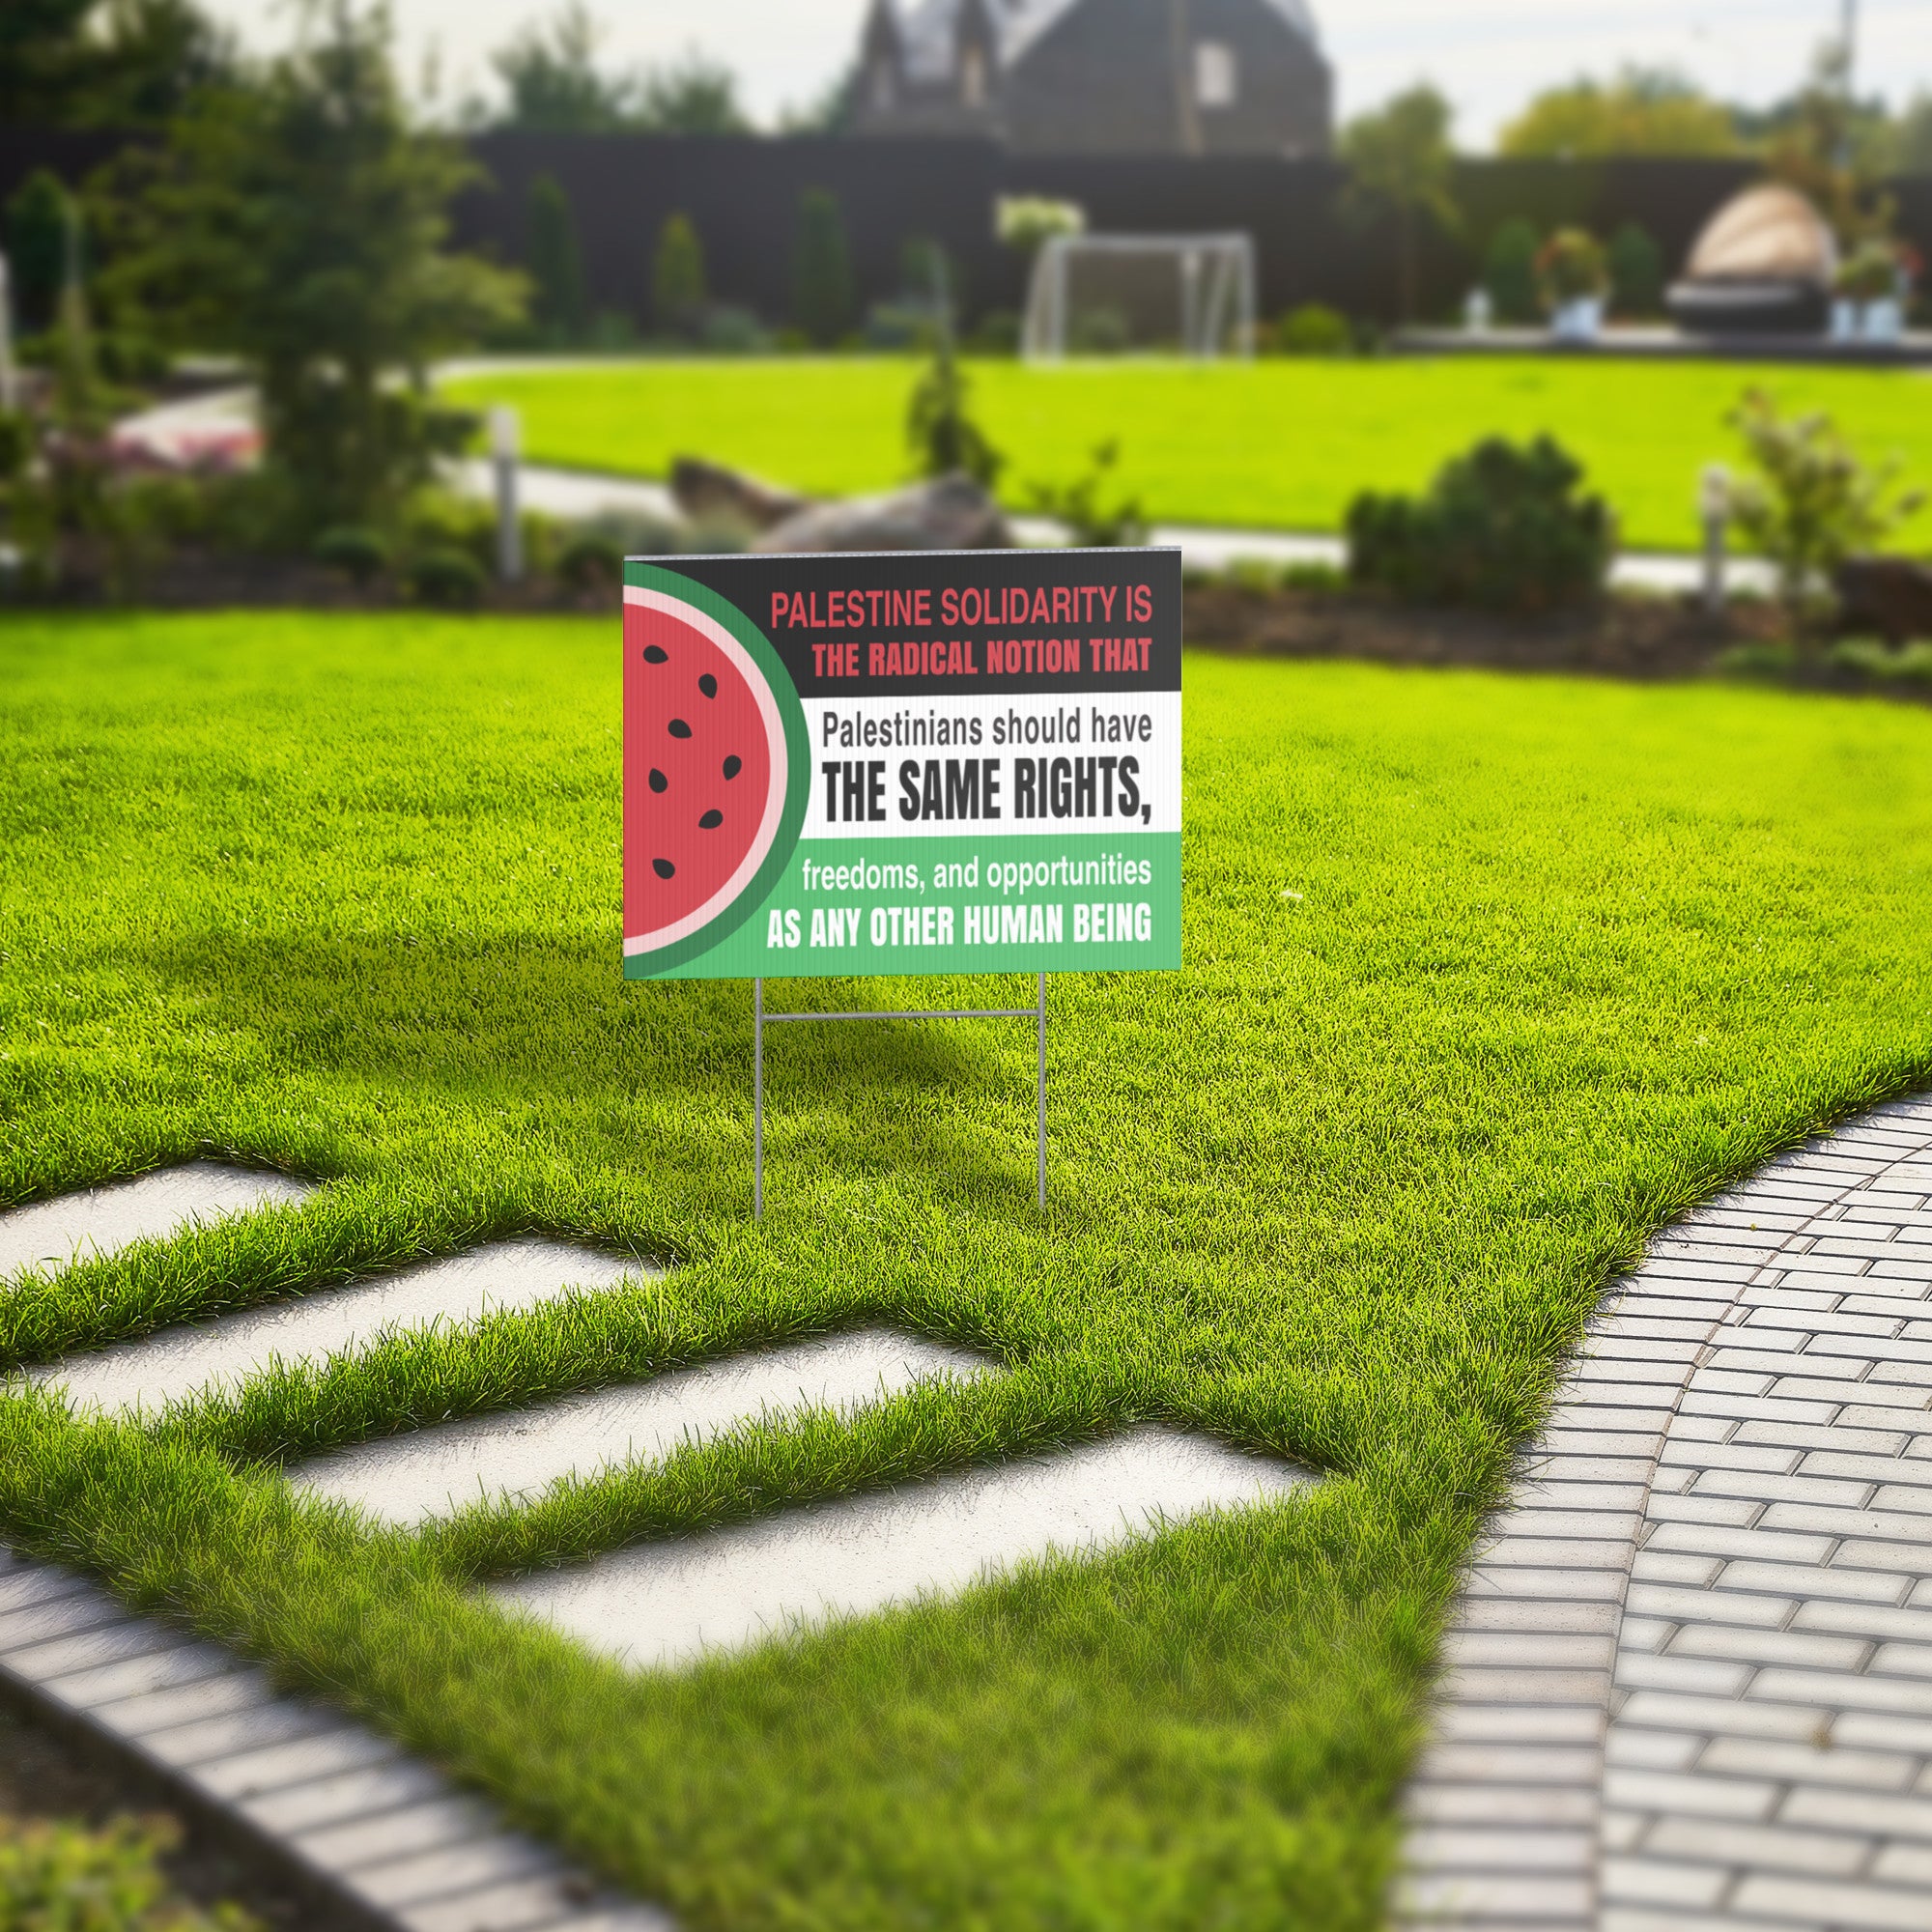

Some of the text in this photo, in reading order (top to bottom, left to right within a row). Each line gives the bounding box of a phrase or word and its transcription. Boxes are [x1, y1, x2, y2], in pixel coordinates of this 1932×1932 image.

[772, 585, 1151, 628] PALESTINE SOLIDARITY IS
[811, 638, 1151, 676] THE RADICAL NOTION THAT
[824, 707, 1151, 747] Palestinians should have
[822, 756, 1151, 824] THE SAME RIGHTS,
[803, 853, 1151, 895] freedoms, and opportunities
[767, 902, 1151, 948] AS ANY OTHER HUMAN BEING
